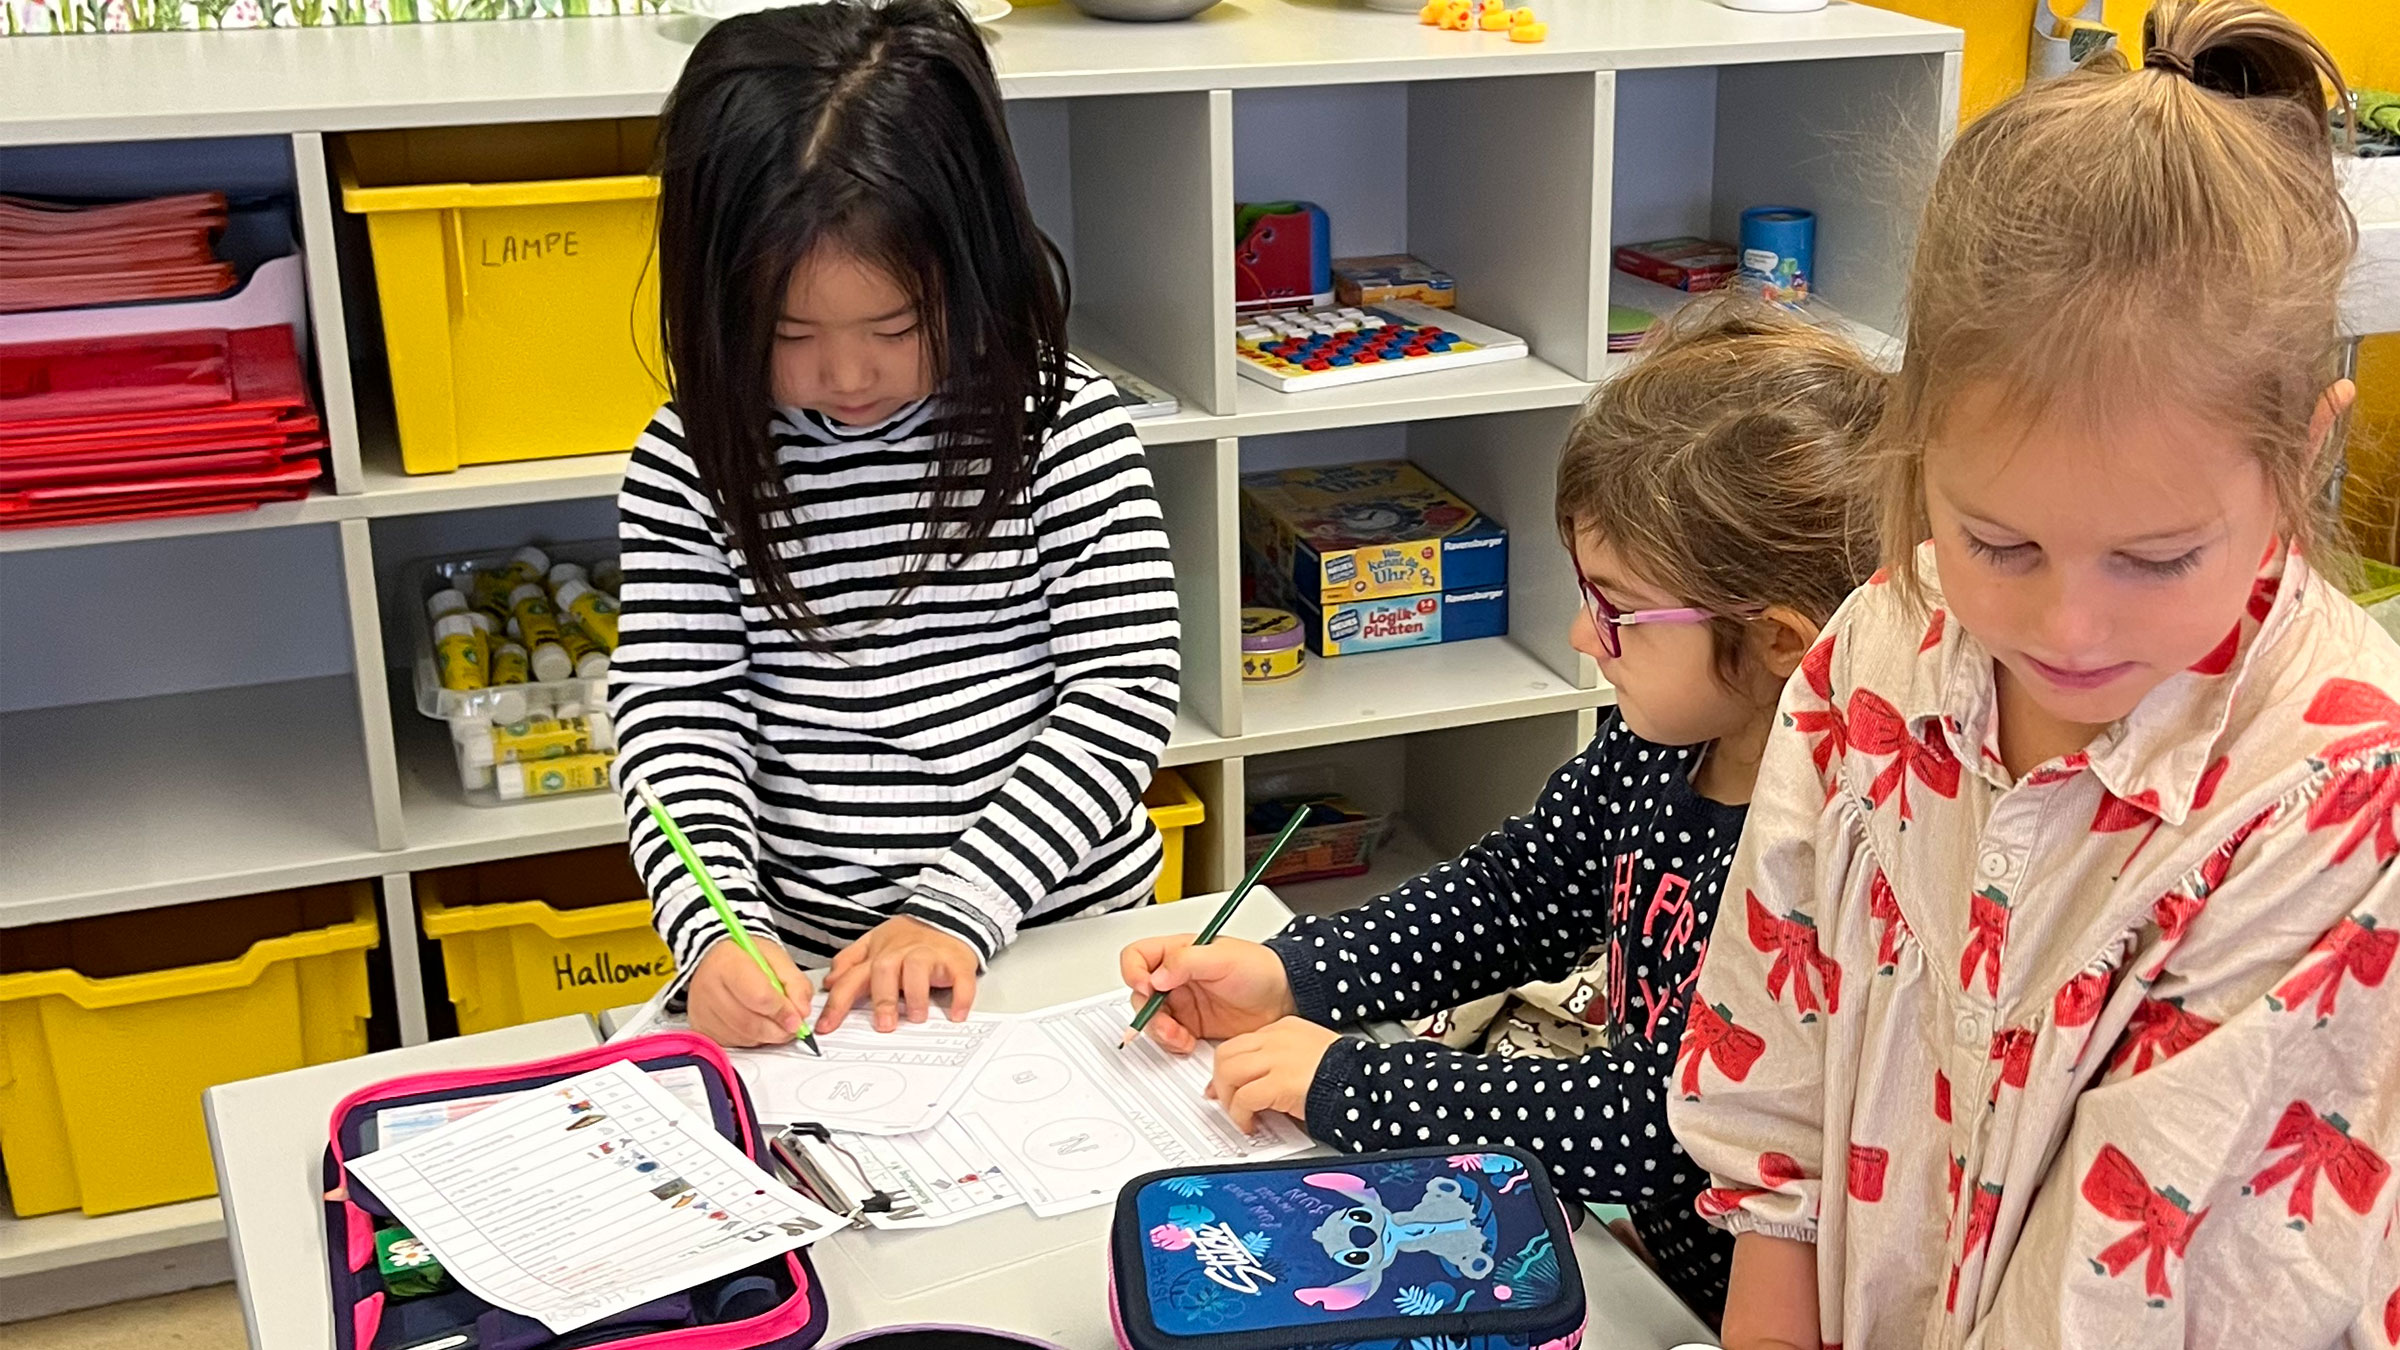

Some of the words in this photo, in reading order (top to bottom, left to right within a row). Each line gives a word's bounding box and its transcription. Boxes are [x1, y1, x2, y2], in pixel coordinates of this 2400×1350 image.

[481, 230, 579, 267] LAMPE
[1444, 538, 1503, 551] Ravensburger
[1374, 567, 1415, 584] Uhr?
[1445, 590, 1504, 604] Ravensburger
[1369, 608, 1417, 627] Logik-
[1363, 621, 1424, 639] Piraten
[1182, 1221, 1277, 1295] Stitch
